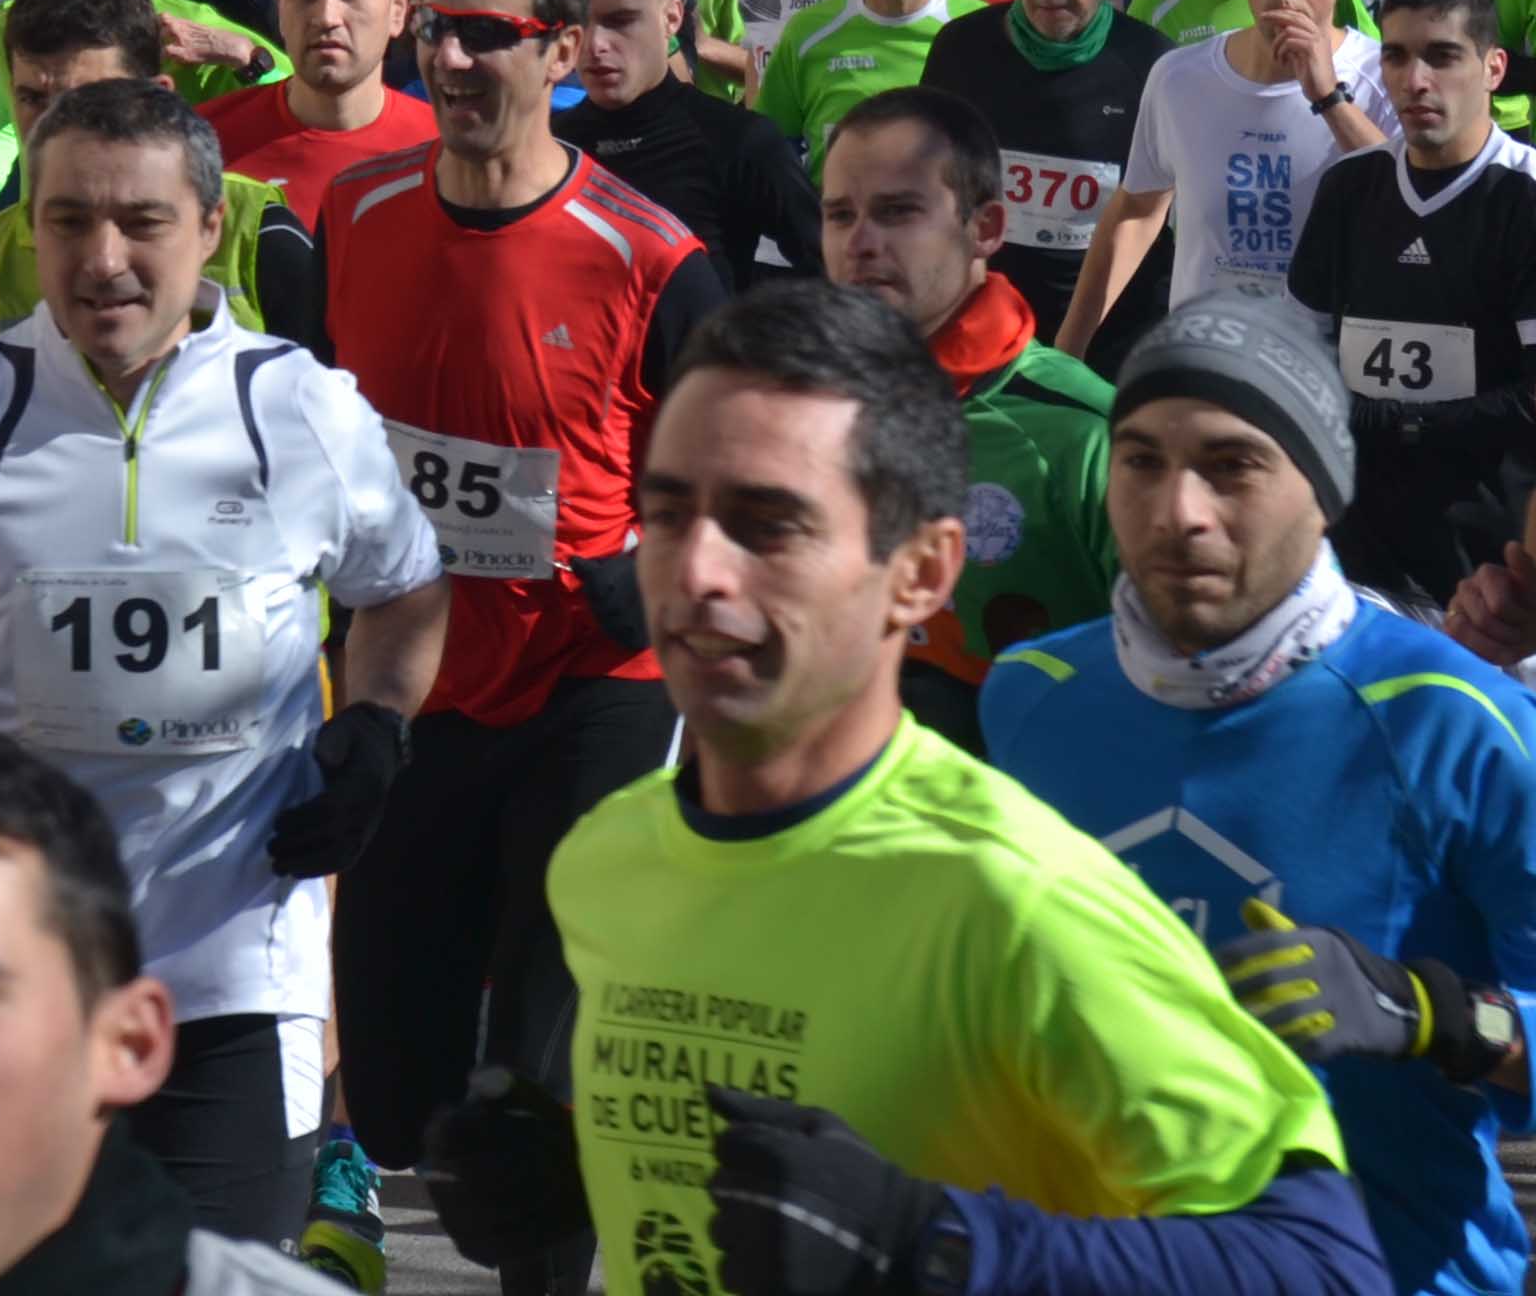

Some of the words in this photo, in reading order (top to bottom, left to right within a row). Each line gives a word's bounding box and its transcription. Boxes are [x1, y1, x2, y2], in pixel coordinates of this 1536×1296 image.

[1005, 164, 1100, 211] 370
[1227, 153, 1292, 190] SM
[1227, 191, 1293, 227] RS
[1229, 228, 1294, 252] 2015
[1363, 337, 1434, 391] 43
[410, 450, 502, 519] 85
[465, 549, 535, 567] Pinocio
[51, 596, 221, 673] 191
[706, 994, 807, 1043] POPULAR
[592, 1094, 620, 1130] DE
